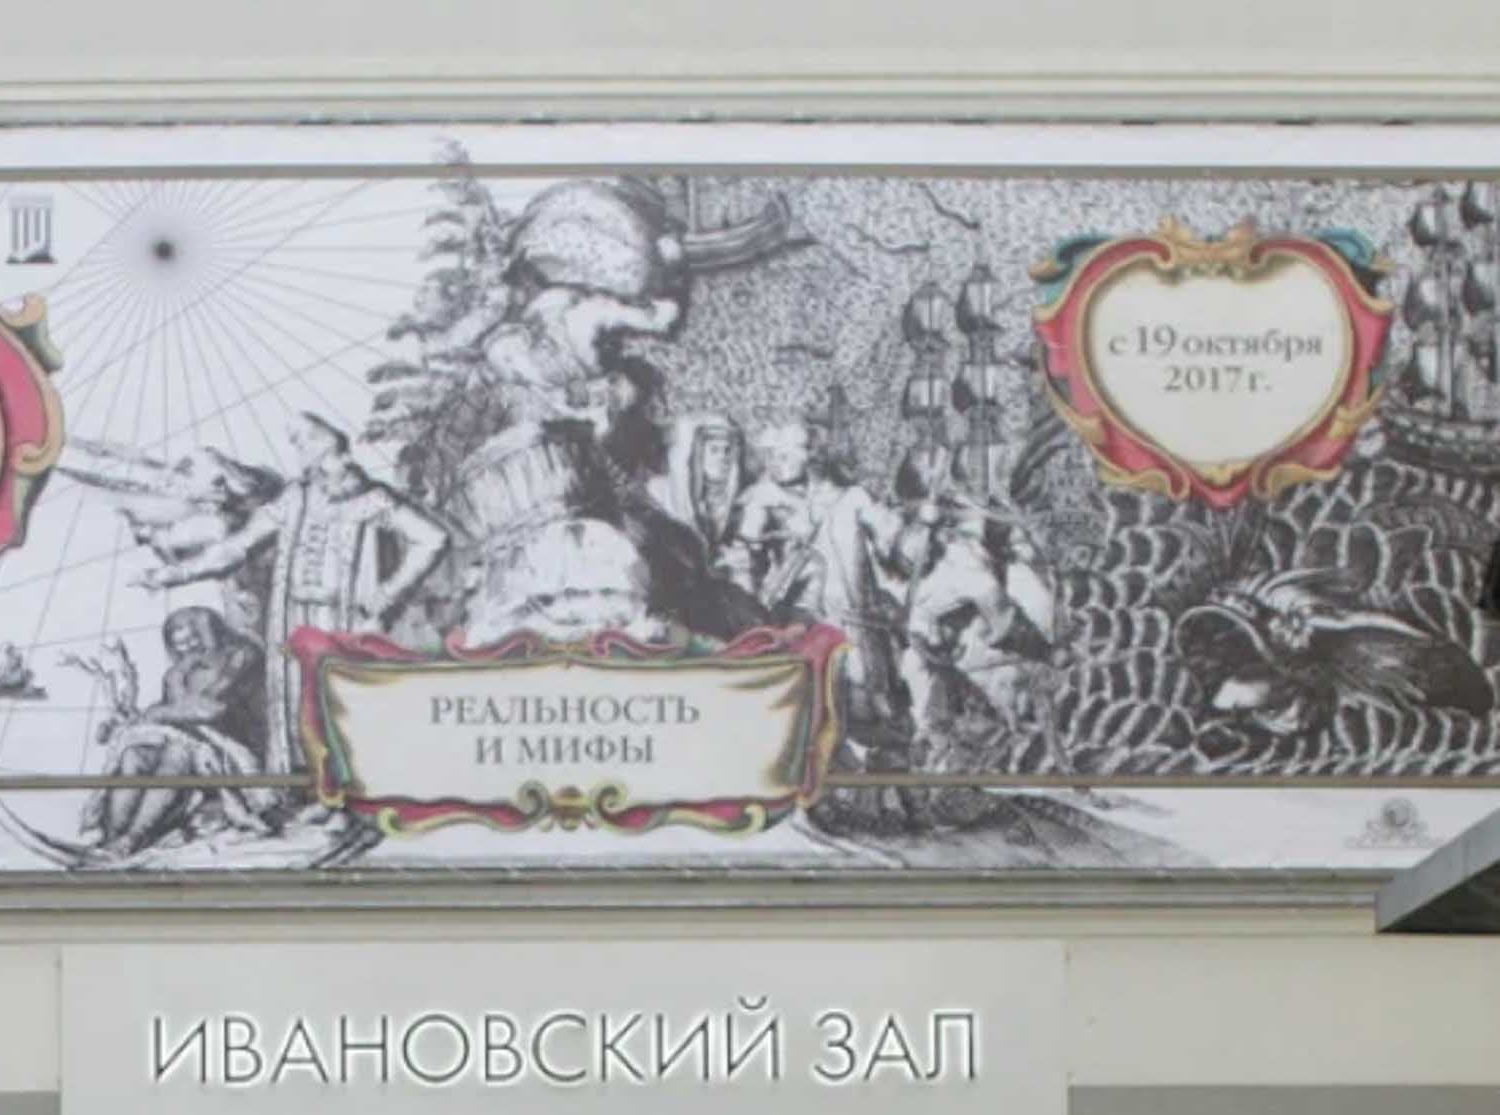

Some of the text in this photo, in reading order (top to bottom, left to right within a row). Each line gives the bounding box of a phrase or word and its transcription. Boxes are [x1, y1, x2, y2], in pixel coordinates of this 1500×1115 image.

[1106, 325, 1323, 363] с 19 октября
[1163, 365, 1272, 393] 2017 г.
[430, 695, 701, 726] РЕАЛЬНОСТЬ
[475, 735, 654, 765] И МИФЫ
[150, 994, 978, 1085] ИВАНОВСКИЙ ЗАЛ
